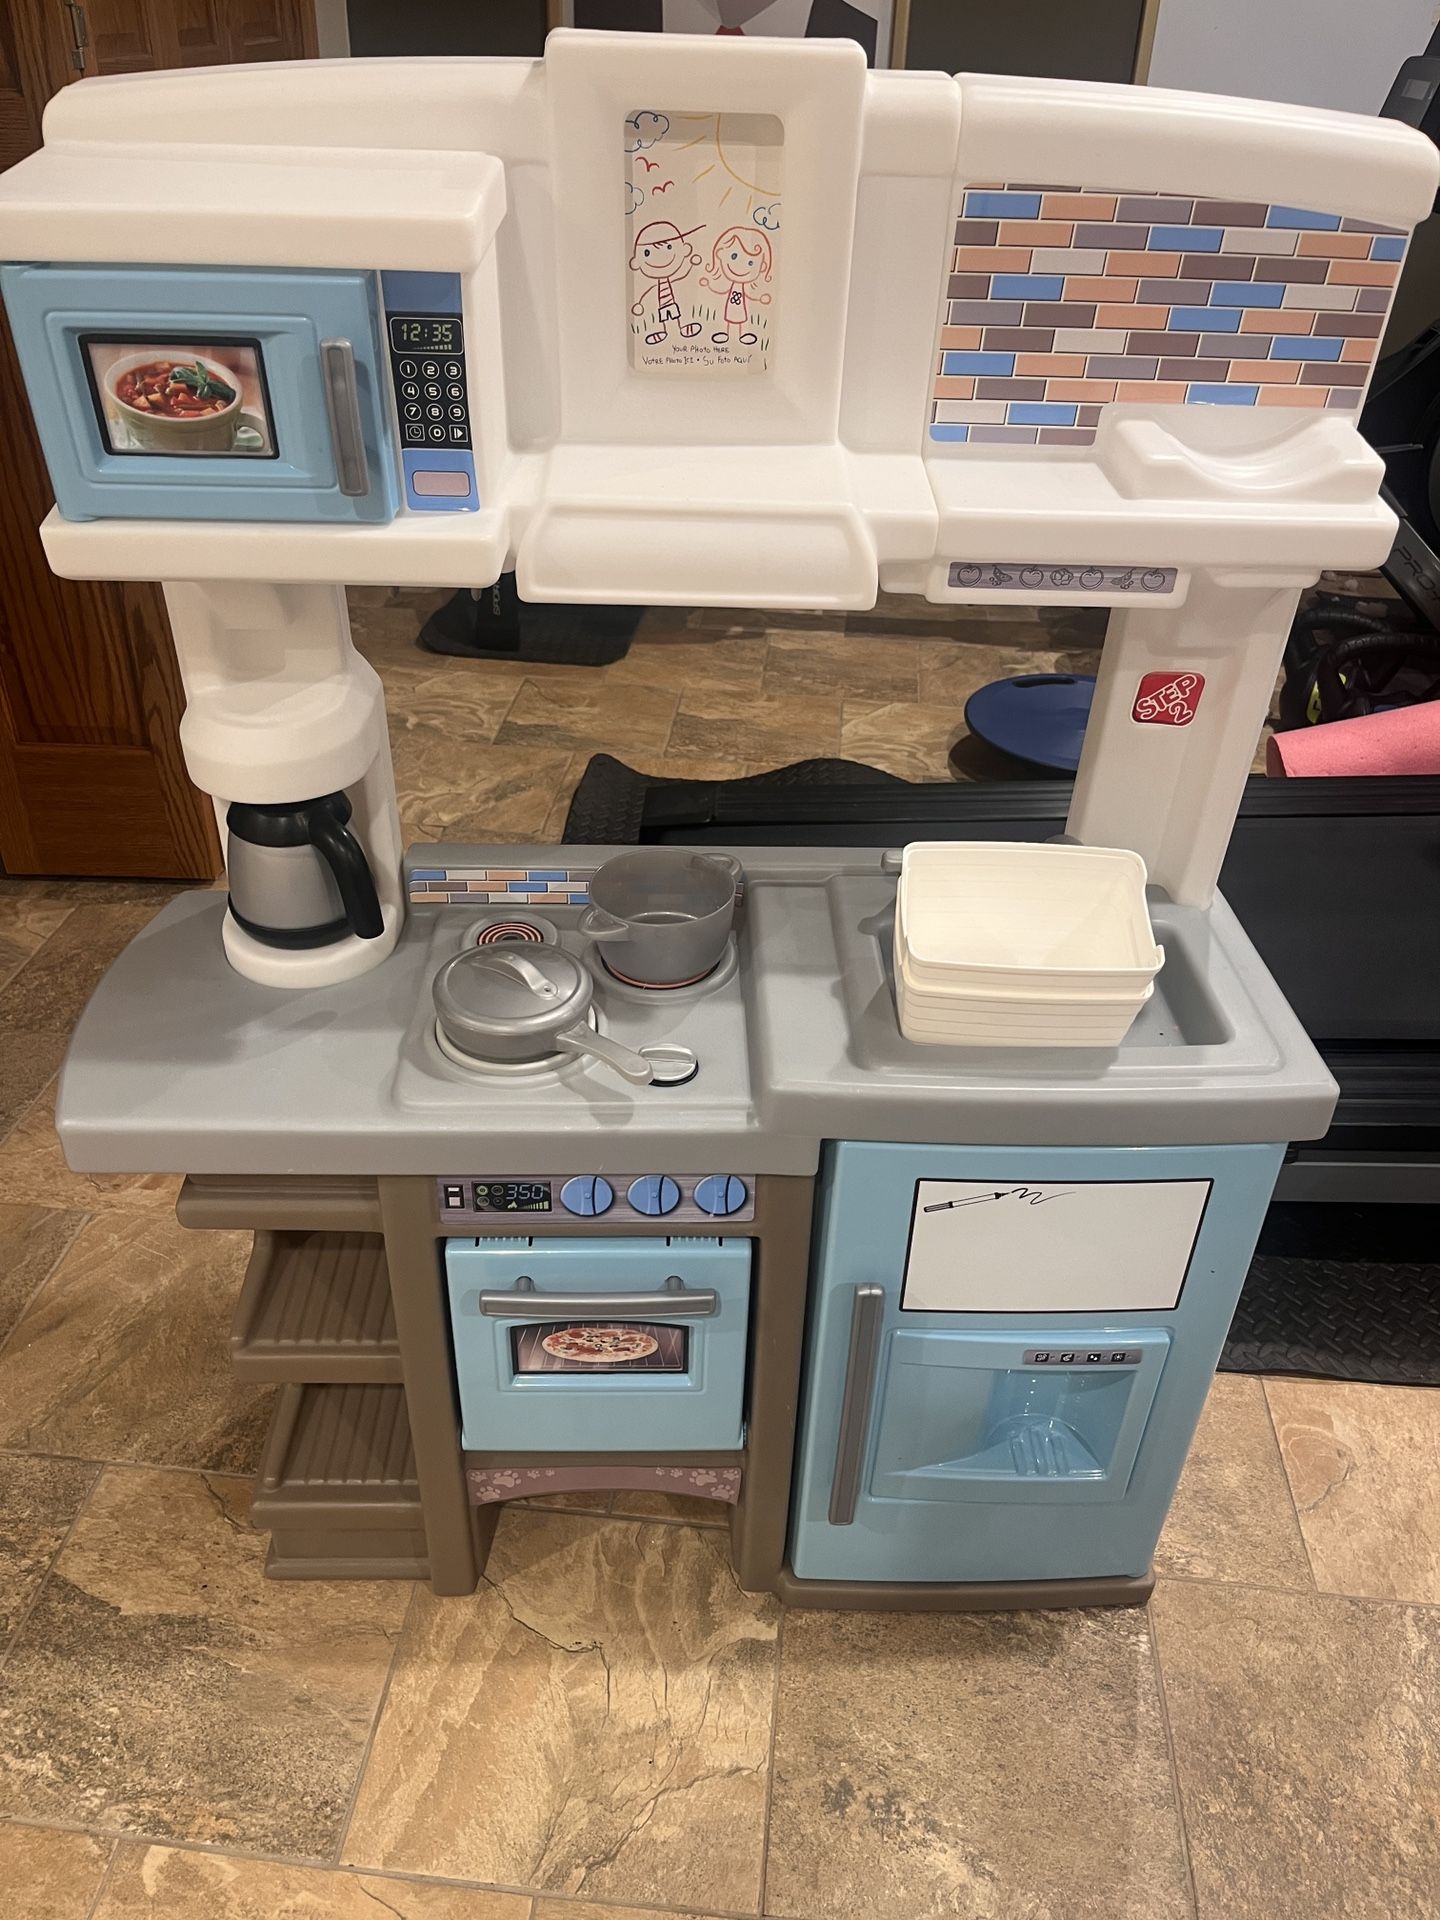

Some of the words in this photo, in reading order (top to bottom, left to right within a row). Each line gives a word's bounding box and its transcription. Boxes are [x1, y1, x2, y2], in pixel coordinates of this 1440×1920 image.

[401, 323, 453, 342] 12:35
[426, 365, 435, 375] 2
[449, 366, 458, 376] 3
[407, 386, 415, 396] 4
[428, 387, 438, 396] 5
[451, 387, 460, 397] 6
[409, 407, 417, 416] 7
[431, 407, 440, 416] 8
[452, 408, 462, 417] 9
[433, 428, 441, 437] 0
[1136, 673, 1198, 720] STEP
[1168, 700, 1193, 724] 2
[505, 1184, 544, 1200] 350
